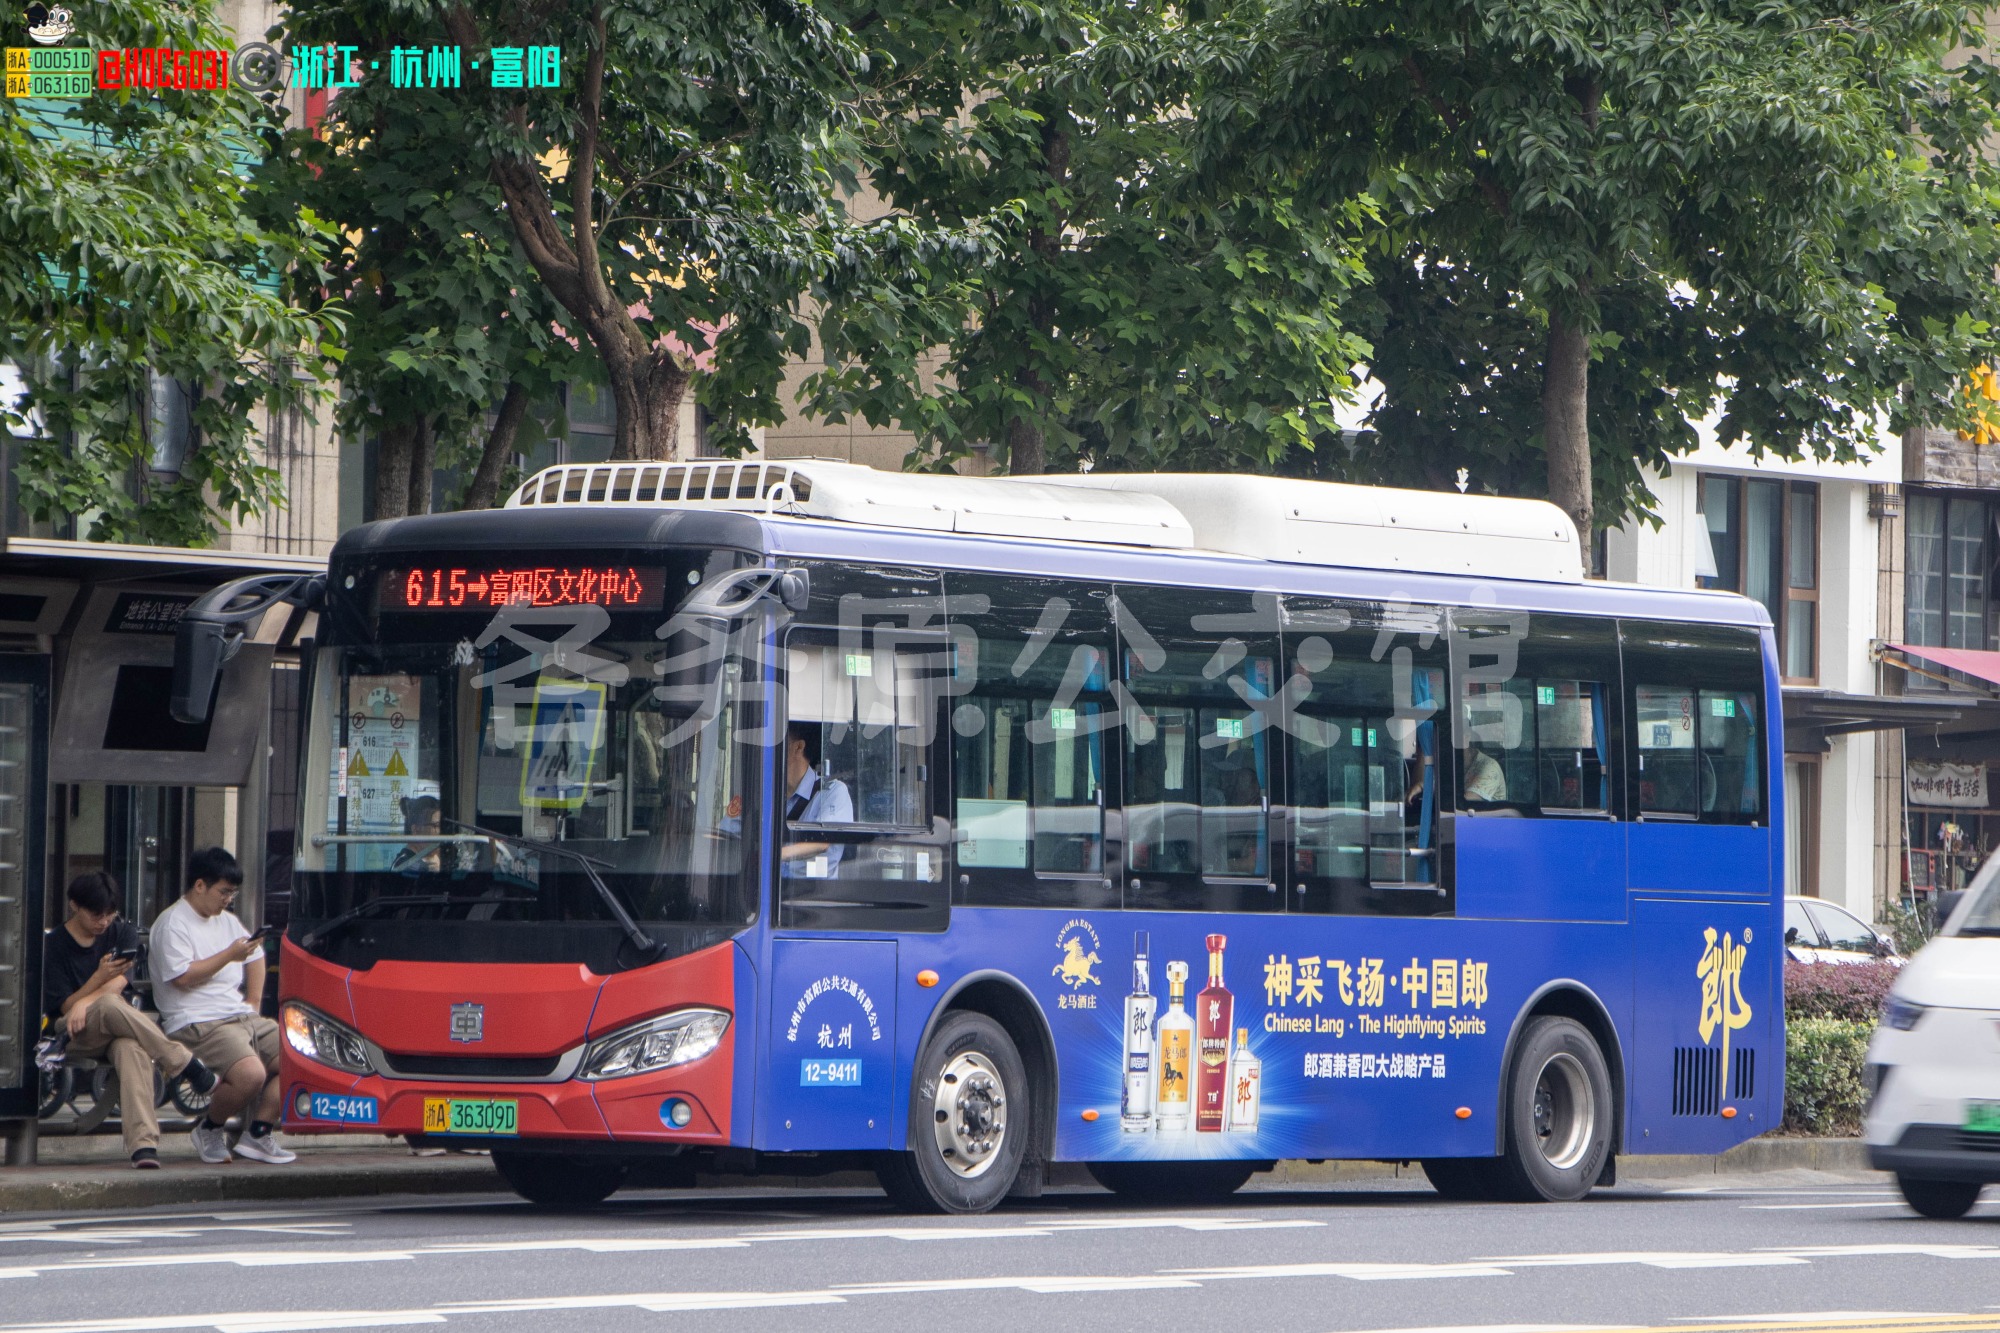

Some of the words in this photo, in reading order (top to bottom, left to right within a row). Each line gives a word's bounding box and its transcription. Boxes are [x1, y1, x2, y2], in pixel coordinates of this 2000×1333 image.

[406, 569, 466, 606] 615
[490, 568, 642, 606] 富阳区文化中心
[363, 736, 376, 747] 616
[362, 788, 376, 800] 627
[1056, 919, 1079, 949] LONGMA
[1079, 919, 1101, 949] ESTATE
[1263, 954, 1489, 1010] 神采飞扬·中国郎
[1057, 994, 1097, 1009] 龙马酒庄
[817, 1023, 852, 1049] 杭州
[1264, 1012, 1312, 1033] Chinese
[1315, 1013, 1345, 1039] Lang
[1358, 1014, 1381, 1034] The
[1384, 1014, 1446, 1040] Highflying
[1448, 1015, 1487, 1040] Spirits
[805, 1063, 858, 1082] 12-9411
[1303, 1052, 1446, 1079] 郎酒兼香四大战略产品
[315, 1097, 373, 1120] 12-9411
